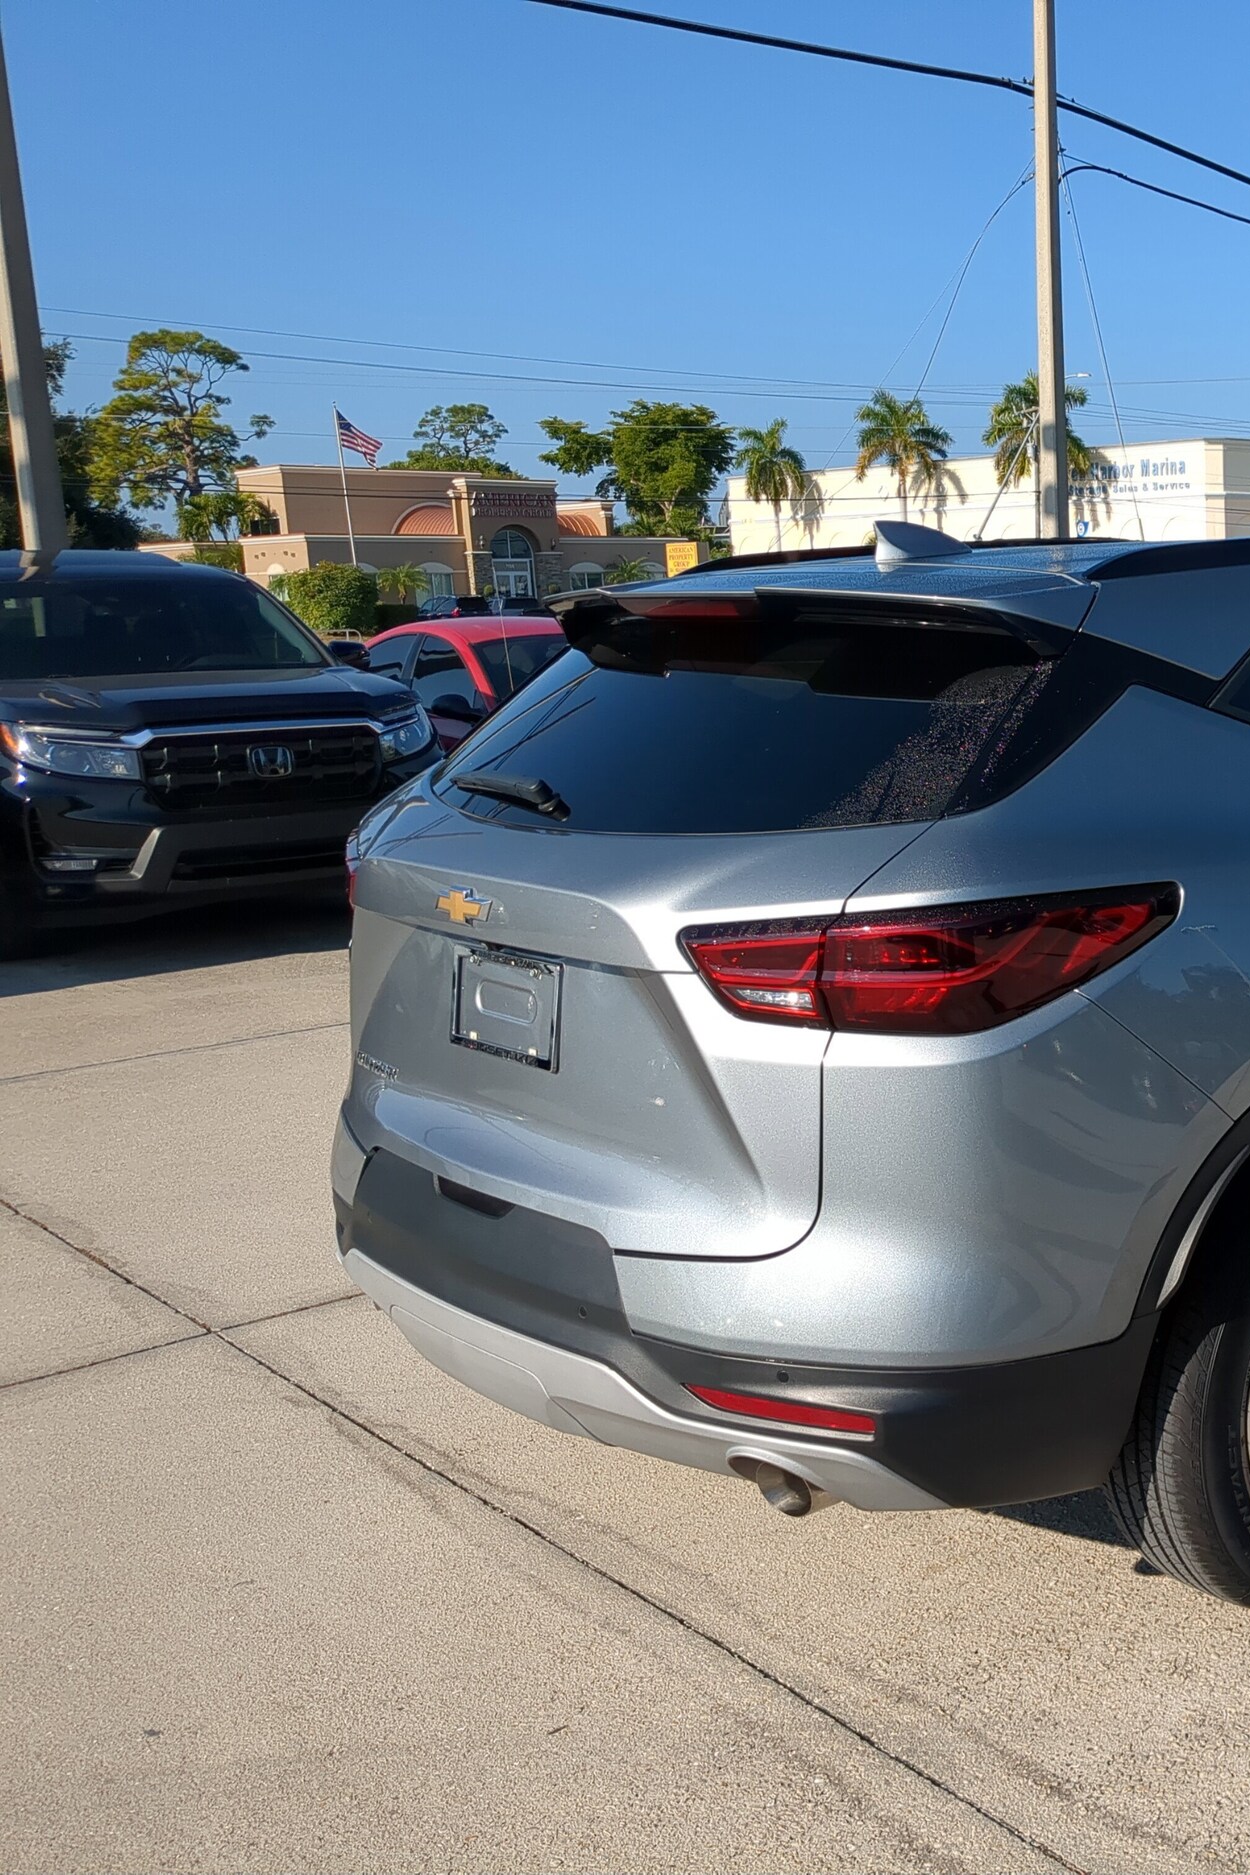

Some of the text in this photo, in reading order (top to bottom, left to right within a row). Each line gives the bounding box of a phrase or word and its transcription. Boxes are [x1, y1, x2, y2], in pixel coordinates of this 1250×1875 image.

[1091, 461, 1134, 480] Harbor
[1140, 458, 1186, 477] Marina
[1113, 484, 1138, 493] Sales
[1142, 483, 1149, 492] &
[1153, 481, 1191, 491] Service
[470, 491, 556, 506] AMERICAN
